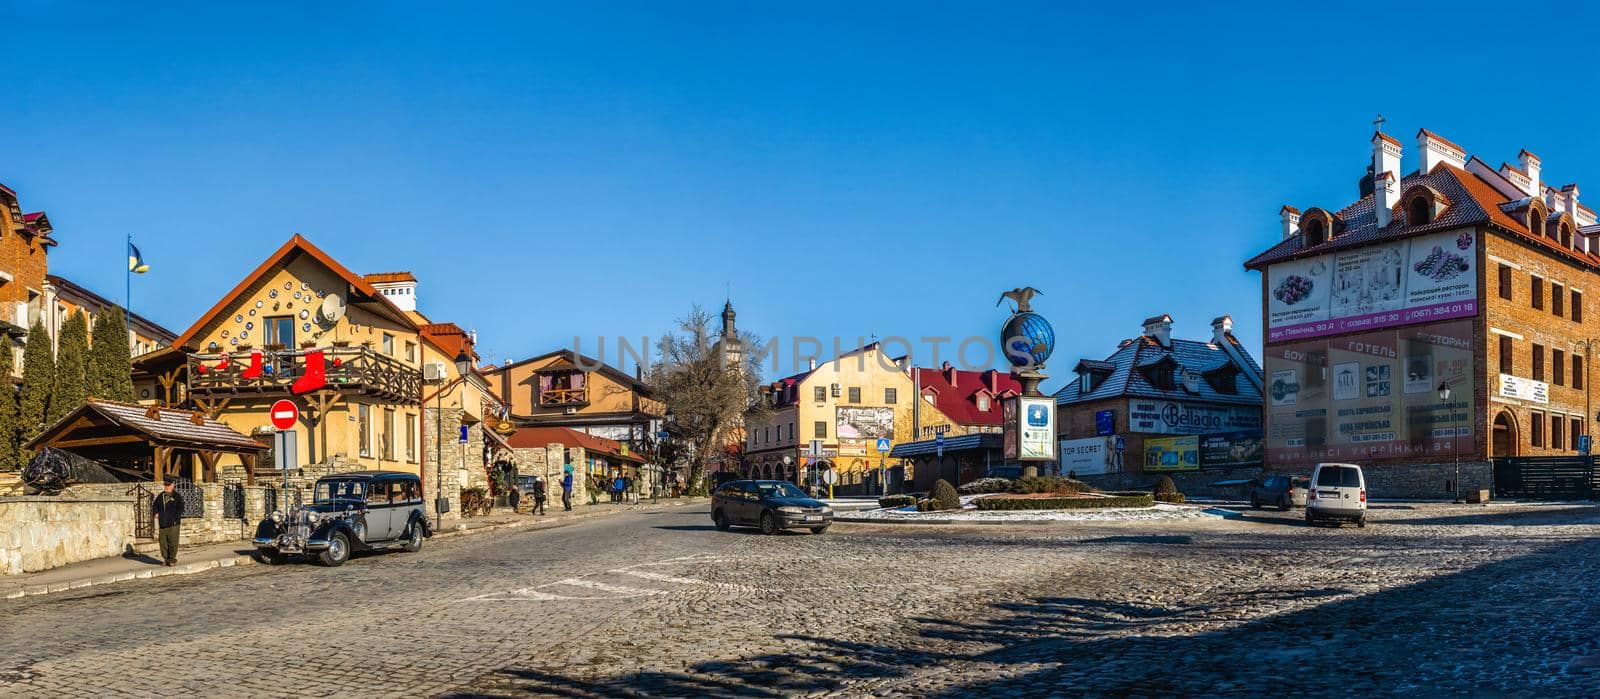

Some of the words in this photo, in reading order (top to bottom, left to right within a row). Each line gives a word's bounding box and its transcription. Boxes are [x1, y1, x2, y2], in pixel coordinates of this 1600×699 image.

[1373, 315, 1387, 324] 915
[1388, 313, 1399, 321] 30
[1433, 306, 1450, 315] 384
[1452, 305, 1462, 313] 01
[1464, 303, 1473, 312] 18
[1349, 341, 1396, 357] ГОТЕЛЬ
[1166, 403, 1221, 430] Bellagio
[1064, 447, 1075, 456] TOP
[1078, 445, 1101, 455] SECRET
